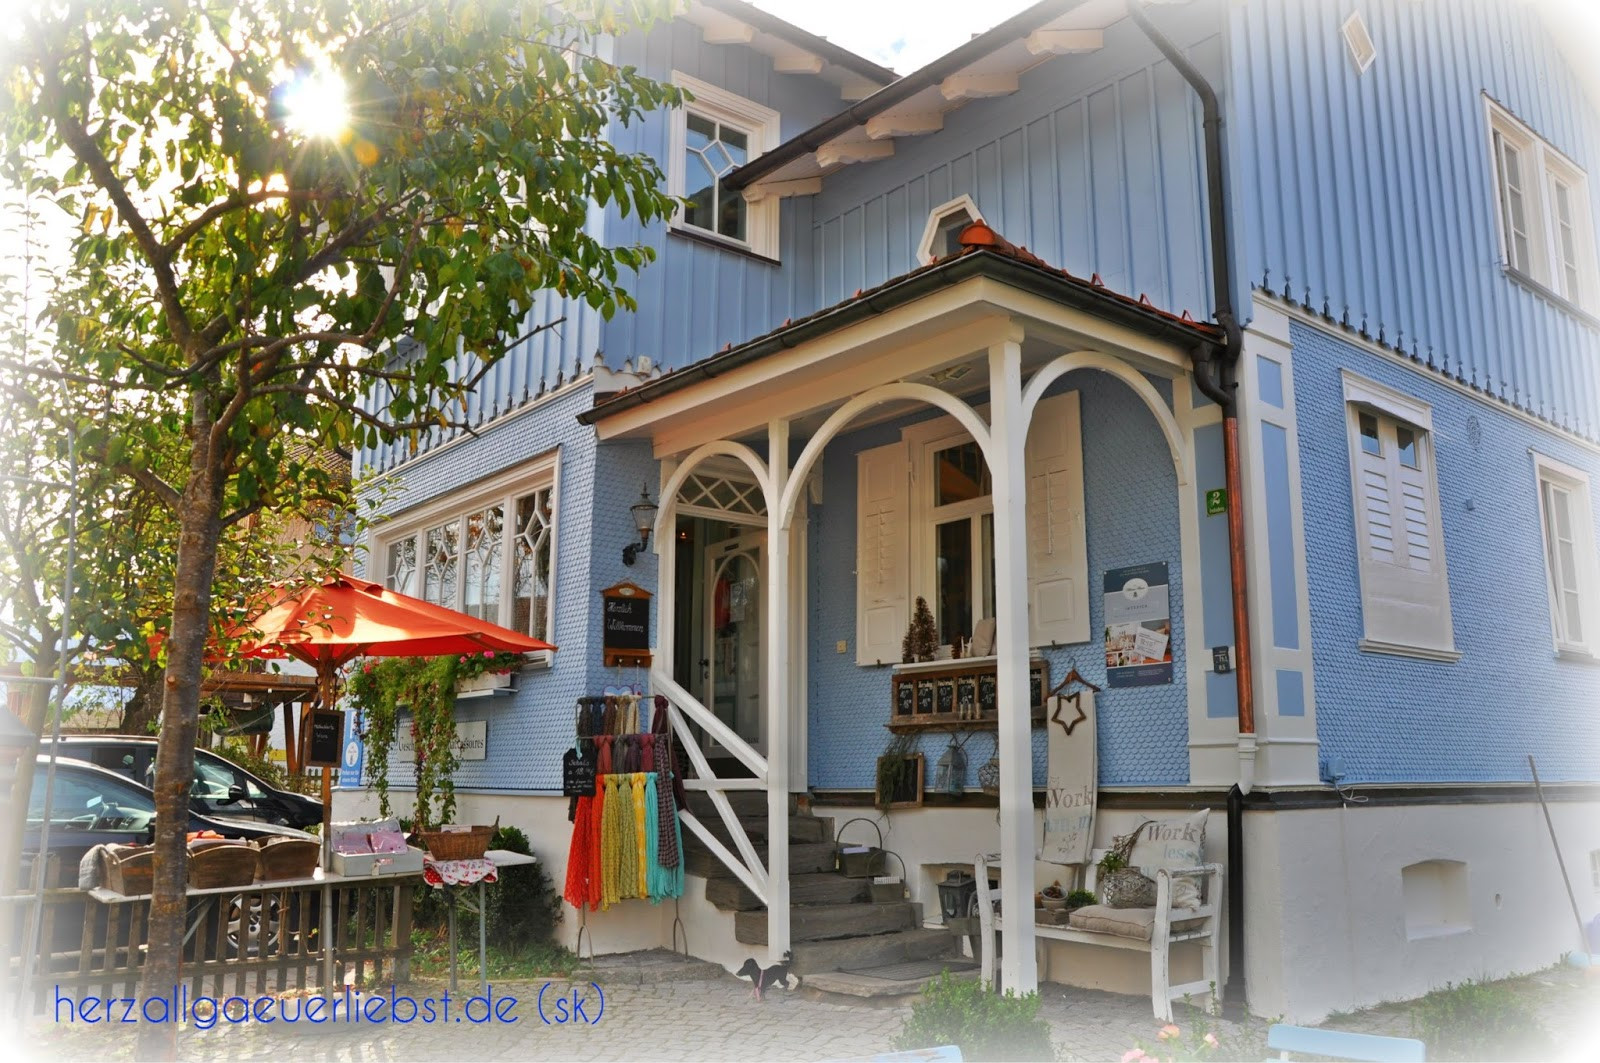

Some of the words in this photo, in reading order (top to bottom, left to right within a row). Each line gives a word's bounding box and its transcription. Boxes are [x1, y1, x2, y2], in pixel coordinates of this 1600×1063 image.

[1212, 491, 1221, 505] 2
[607, 601, 633, 614] Herzlich
[607, 618, 644, 633] Willkommen
[1046, 785, 1093, 809] Work
[1147, 822, 1197, 842] Work
